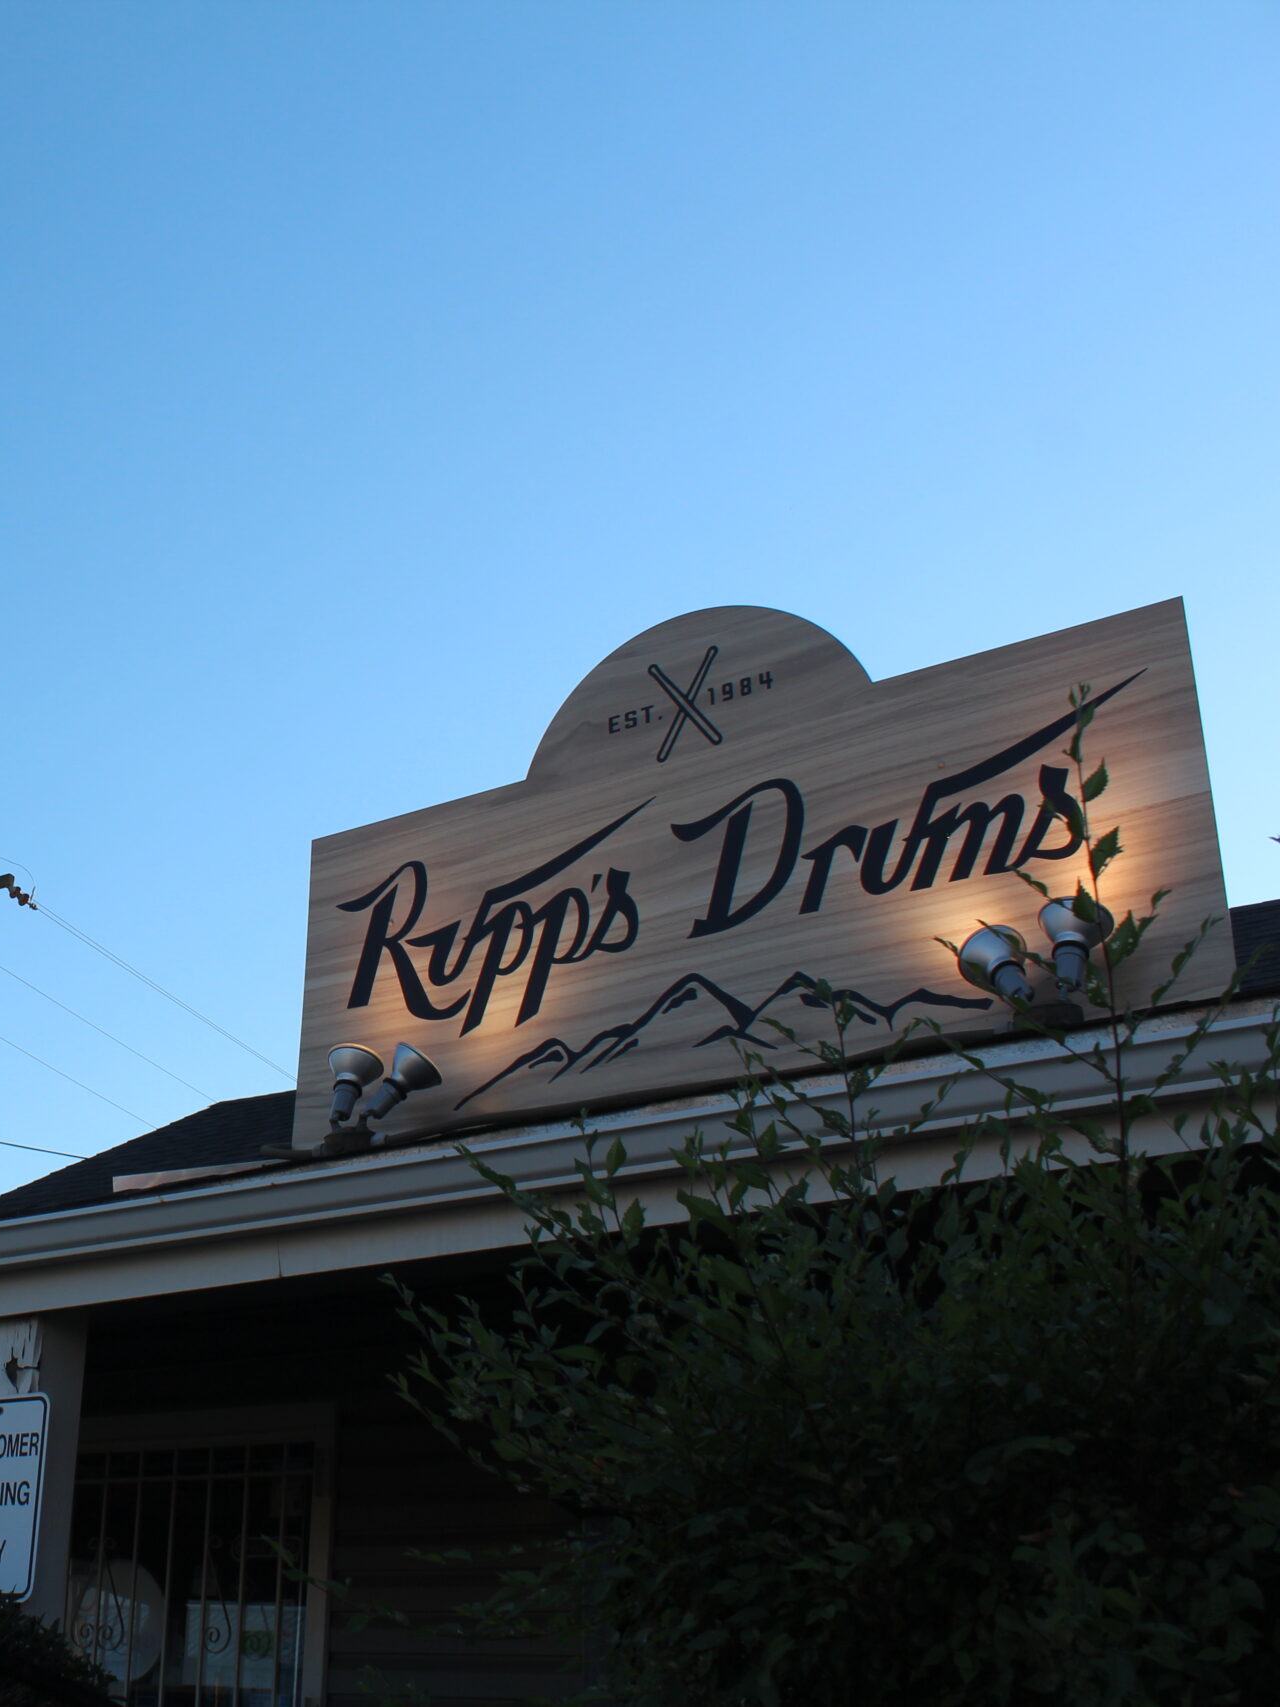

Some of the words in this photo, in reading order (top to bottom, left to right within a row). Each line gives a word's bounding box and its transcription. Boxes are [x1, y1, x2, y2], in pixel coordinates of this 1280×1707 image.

[608, 705, 663, 734] EST.
[707, 671, 773, 705] 1984
[336, 796, 657, 1037] Rupp's
[670, 668, 1148, 940] Drums
